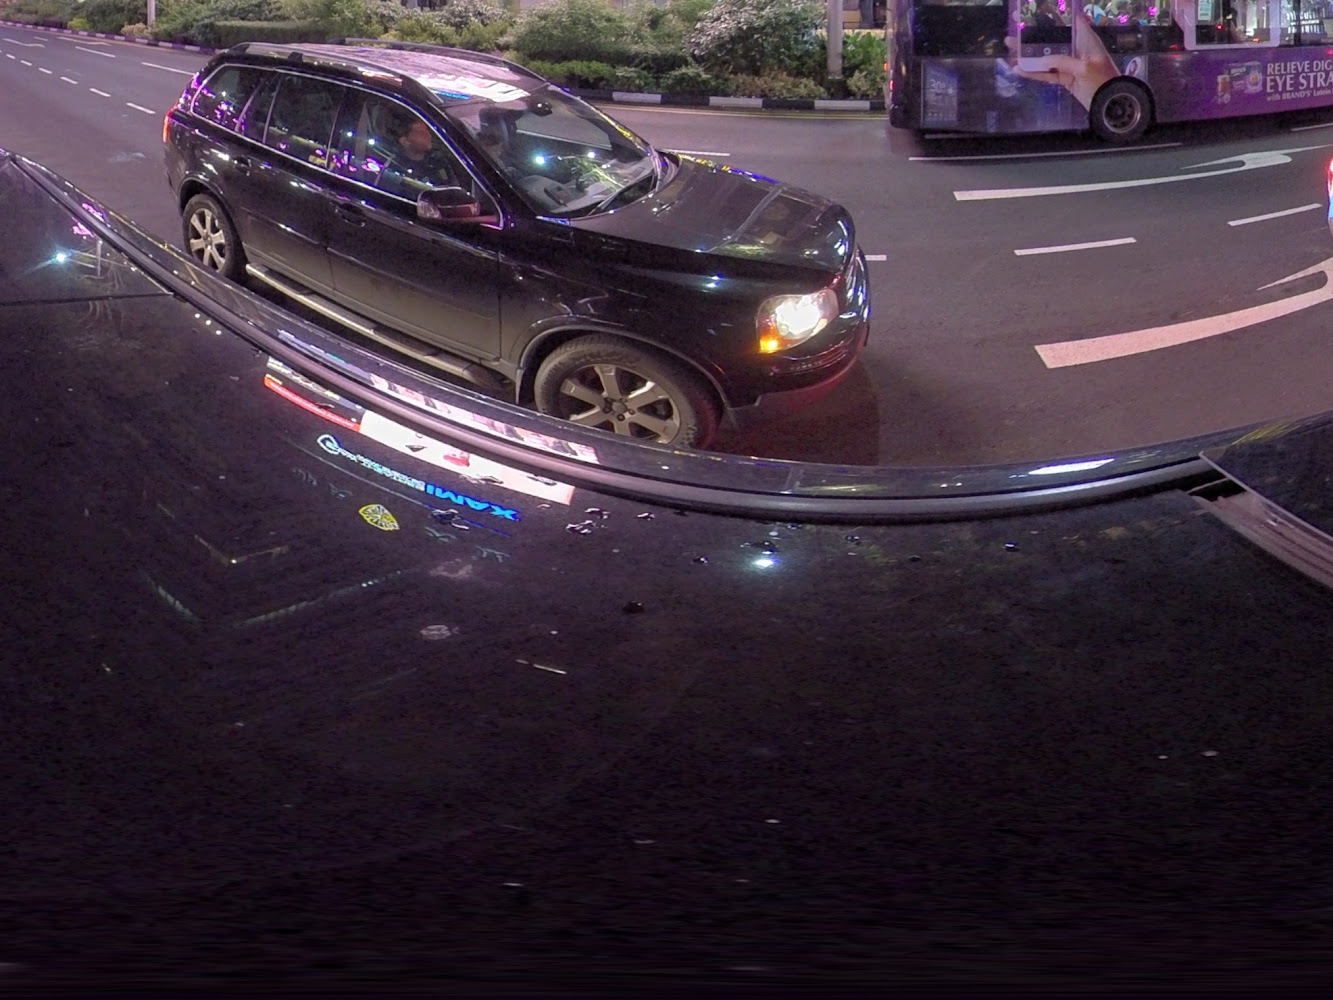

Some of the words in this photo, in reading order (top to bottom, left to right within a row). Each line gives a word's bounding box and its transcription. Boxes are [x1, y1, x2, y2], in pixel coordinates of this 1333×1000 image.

[1267, 61, 1310, 75] RELIEVE
[1266, 74, 1295, 93] EYE
[1267, 93, 1281, 101] with
